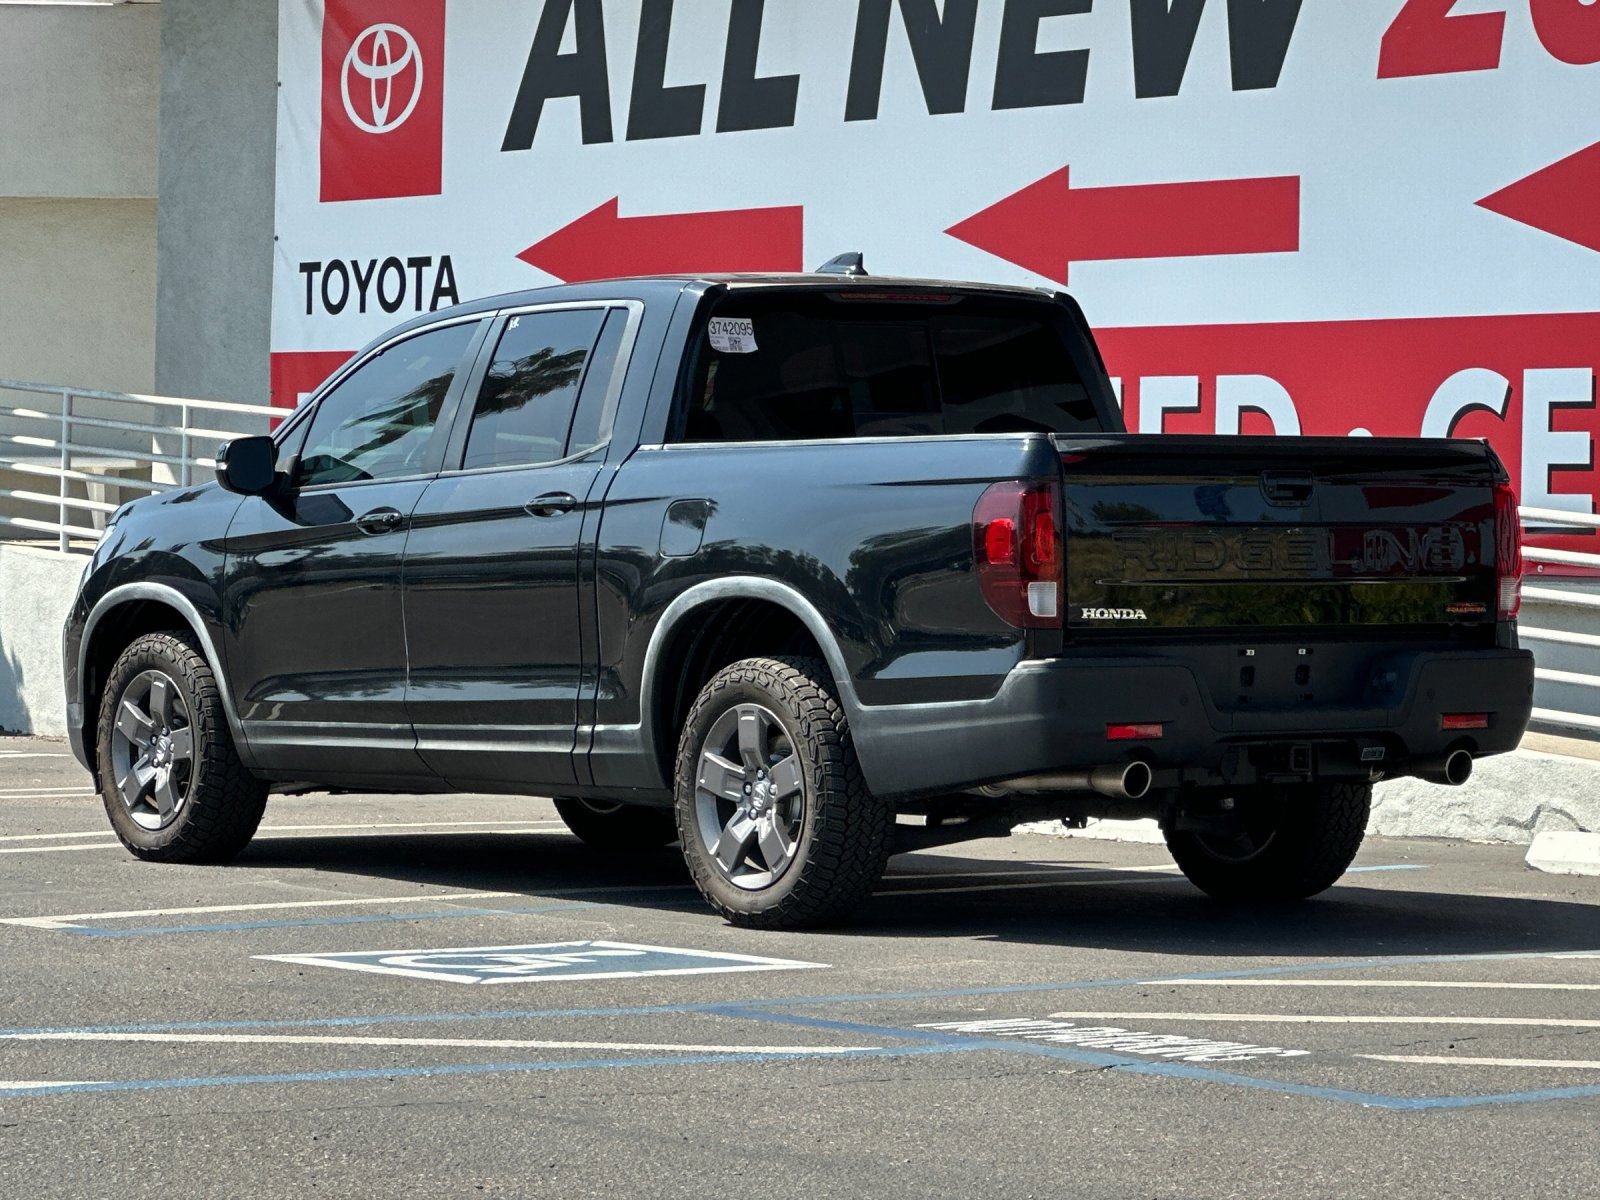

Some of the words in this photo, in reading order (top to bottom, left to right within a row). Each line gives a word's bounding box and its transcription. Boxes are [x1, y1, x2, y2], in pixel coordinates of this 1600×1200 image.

[500, 0, 800, 152] ALL
[299, 255, 460, 315] TOYOTA
[709, 320, 754, 336] 3742095
[1112, 530, 1465, 572] RIDGELINE
[1081, 607, 1147, 620] HONDA
